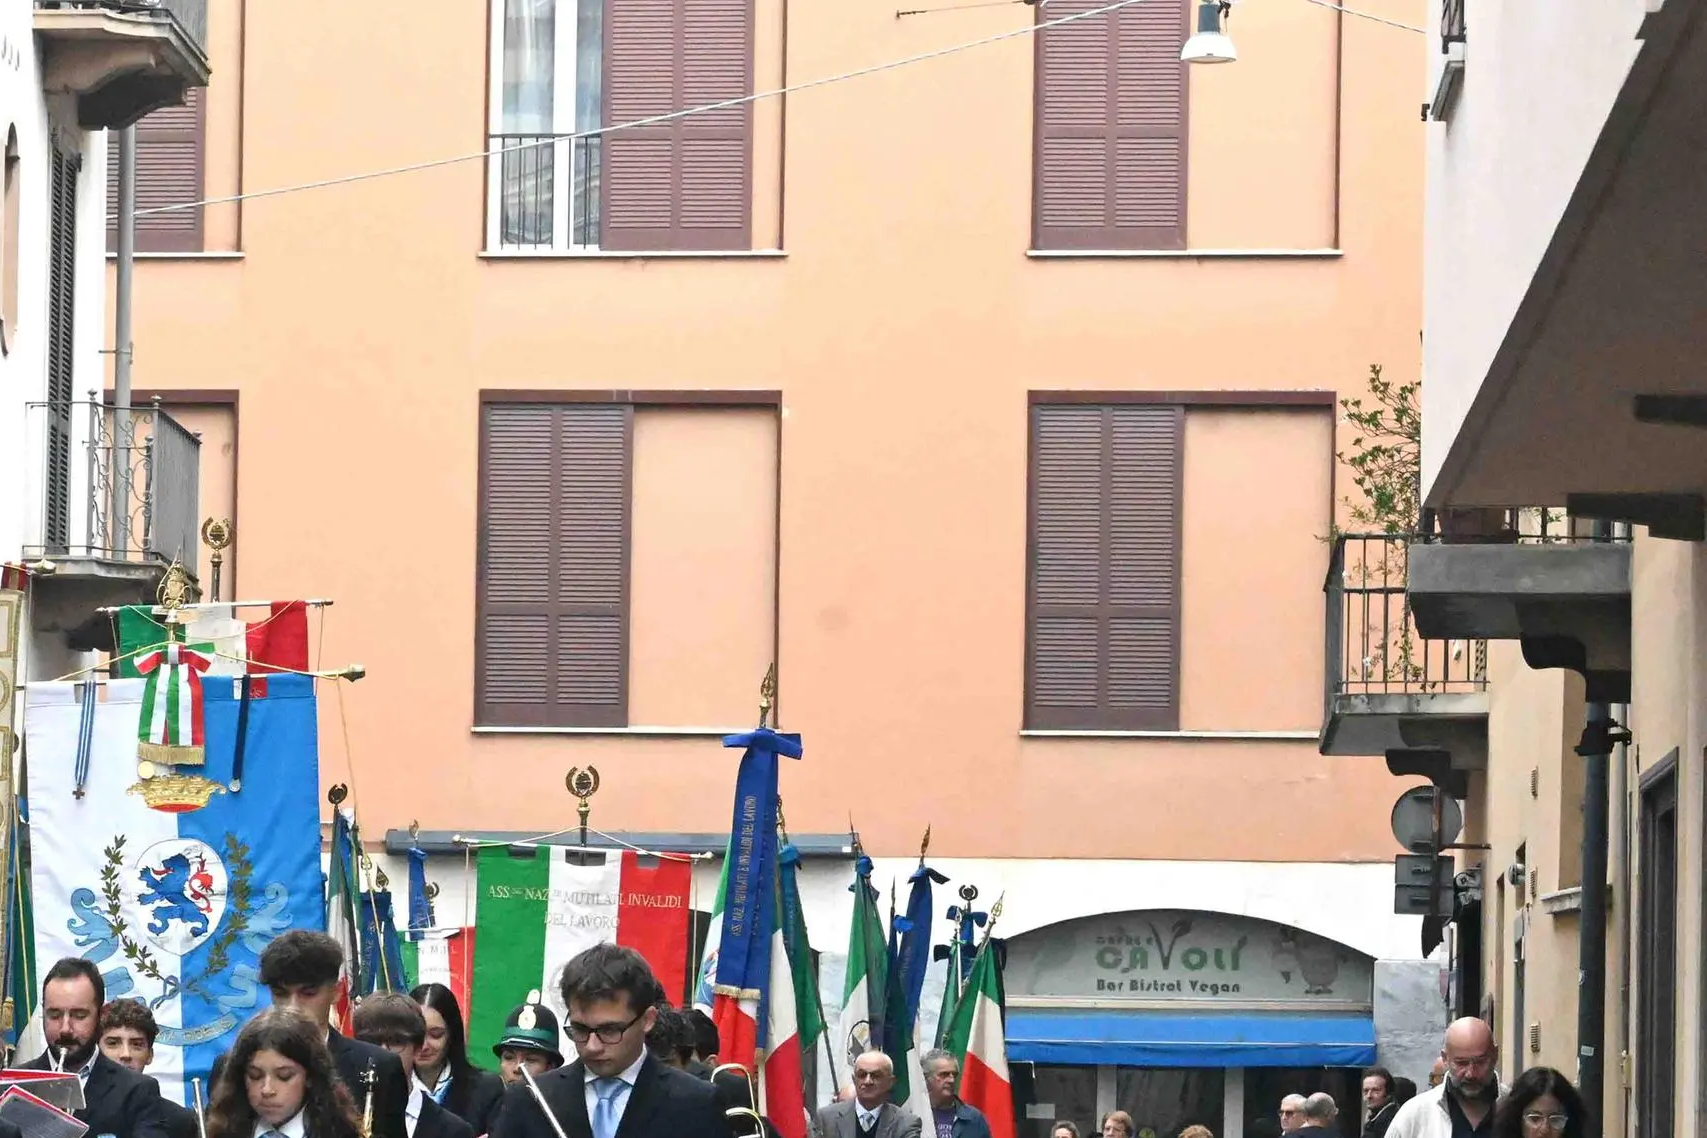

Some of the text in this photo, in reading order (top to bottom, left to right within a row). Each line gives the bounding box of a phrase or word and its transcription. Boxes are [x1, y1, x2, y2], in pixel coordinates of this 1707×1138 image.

[628, 893, 682, 908] INVALIDI
[544, 911, 620, 928] DEL LAVORO
[1096, 978, 1124, 992] Bar
[1189, 979, 1240, 996] Vegan
